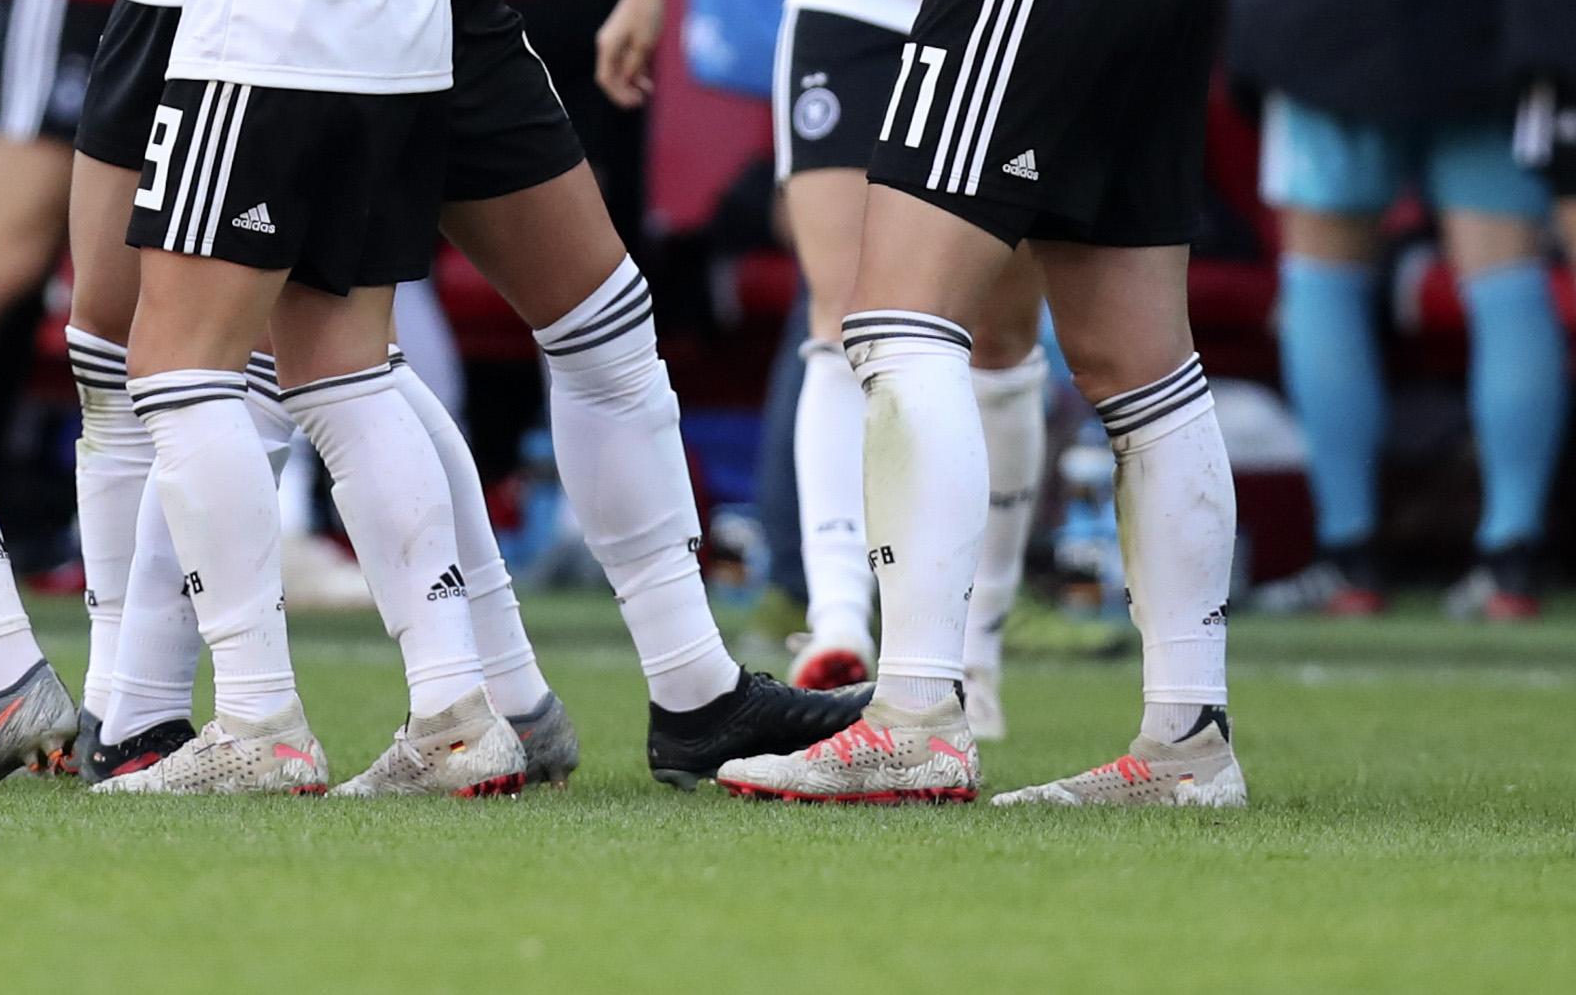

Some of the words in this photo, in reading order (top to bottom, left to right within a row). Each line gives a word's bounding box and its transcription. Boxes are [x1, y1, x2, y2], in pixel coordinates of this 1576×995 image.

[879, 43, 947, 148] 11
[134, 105, 183, 212] 9
[1002, 163, 1039, 181] adidas
[232, 217, 276, 234] adidas
[867, 545, 895, 571] FB
